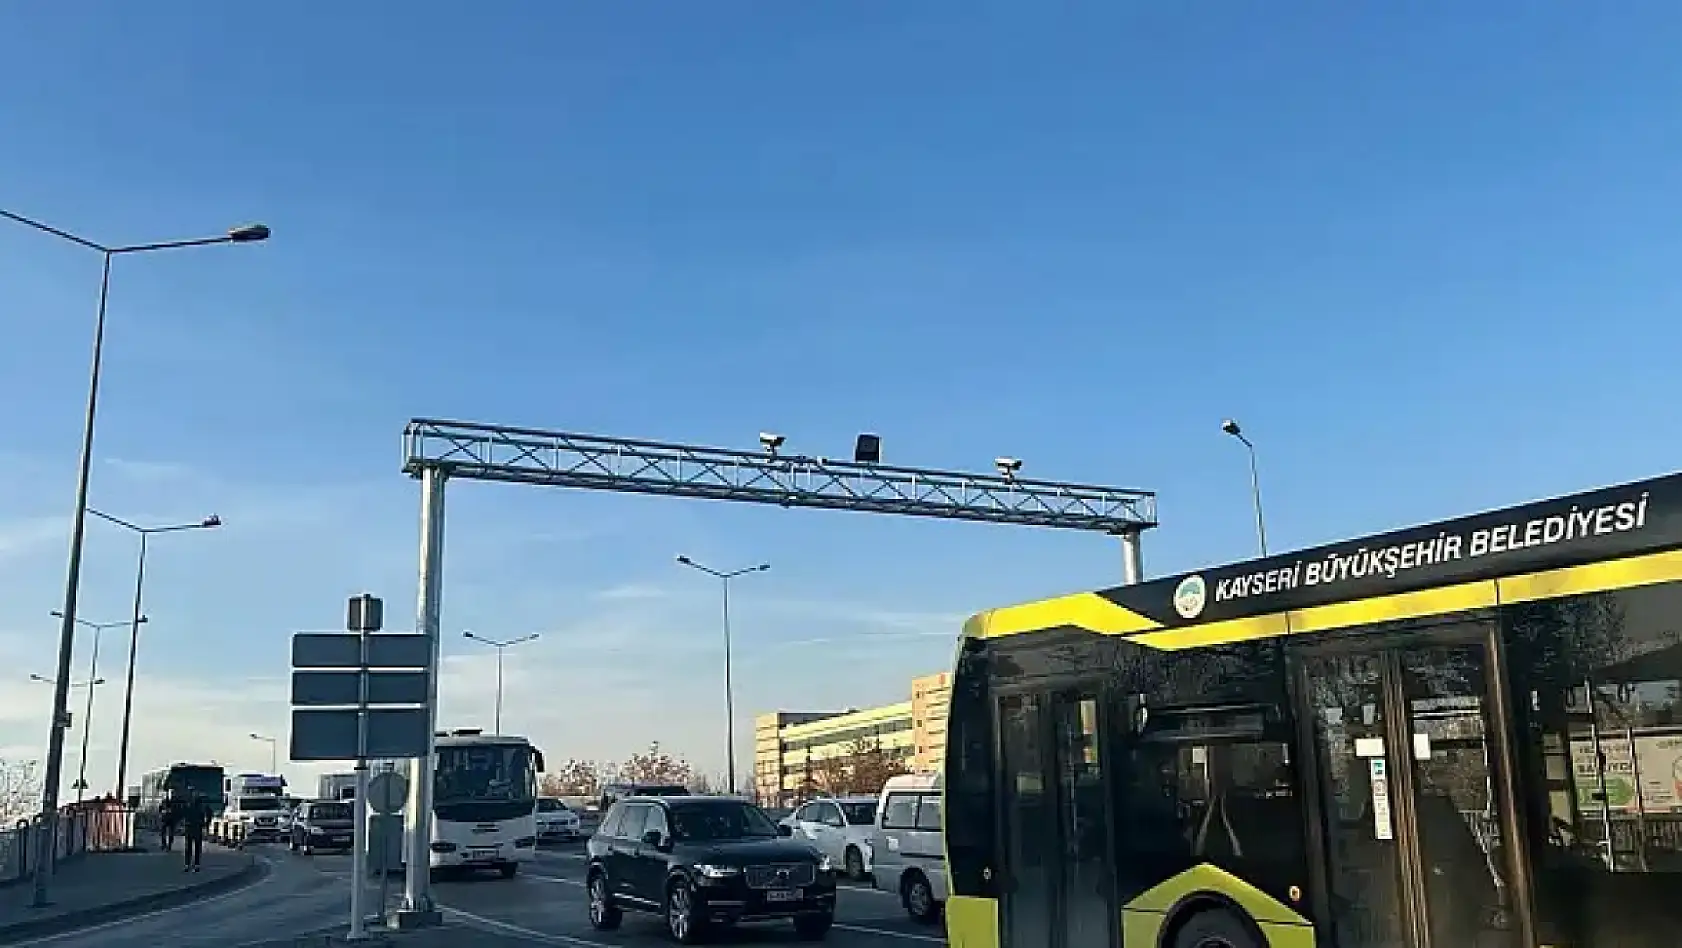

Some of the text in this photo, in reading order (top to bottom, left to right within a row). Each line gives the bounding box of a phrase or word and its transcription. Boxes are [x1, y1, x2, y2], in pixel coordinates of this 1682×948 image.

[1215, 492, 1649, 602] KAYSERİ BÜYÜKŞEHİR BELEDİYESİ
